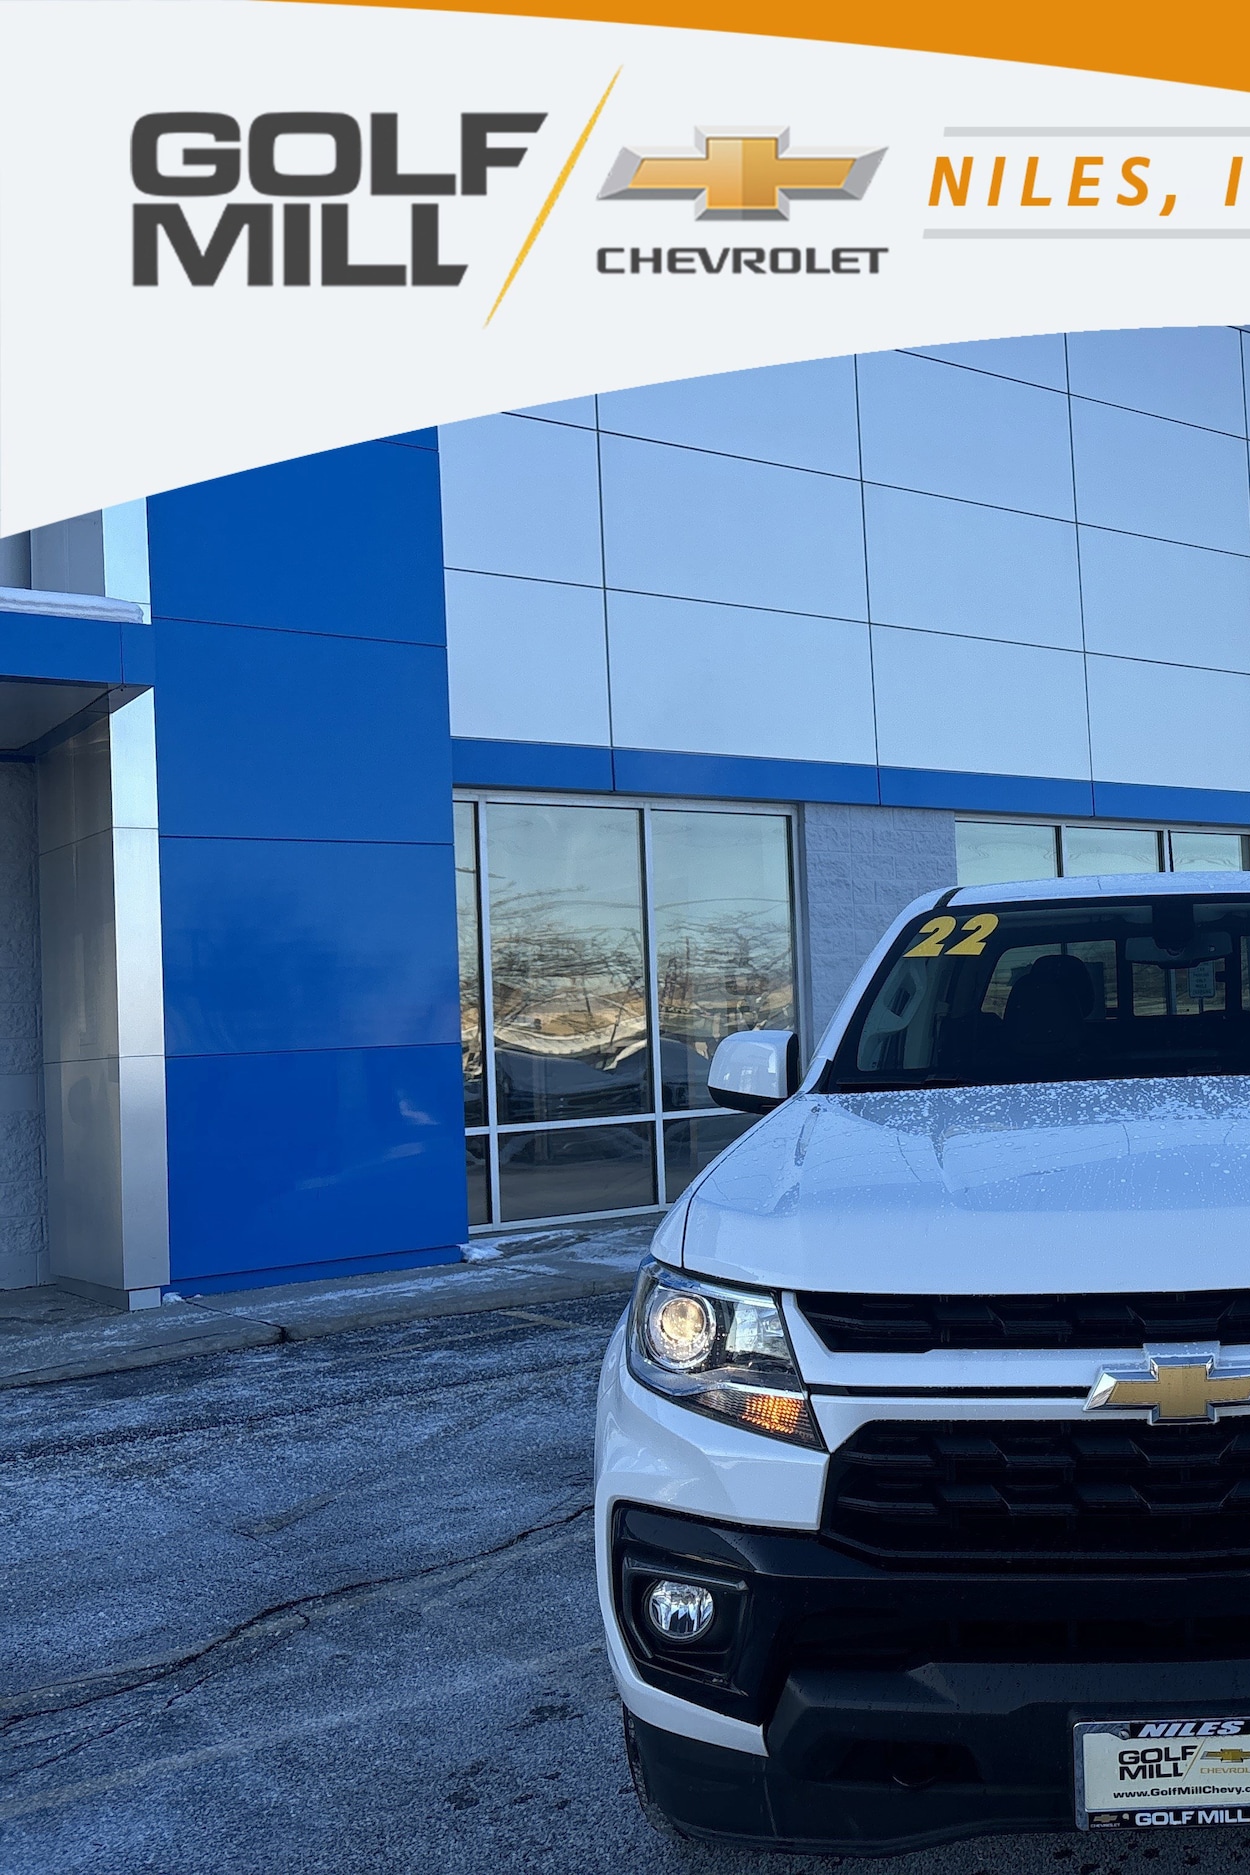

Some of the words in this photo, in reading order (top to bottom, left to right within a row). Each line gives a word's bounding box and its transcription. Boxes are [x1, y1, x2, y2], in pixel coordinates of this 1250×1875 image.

[903, 913, 998, 957] 22
[1137, 1720, 1245, 1737] NILES
[1118, 1745, 1198, 1765] GOLF
[1119, 1762, 1184, 1780] MILL
[1135, 1811, 1195, 1826] GOLF
